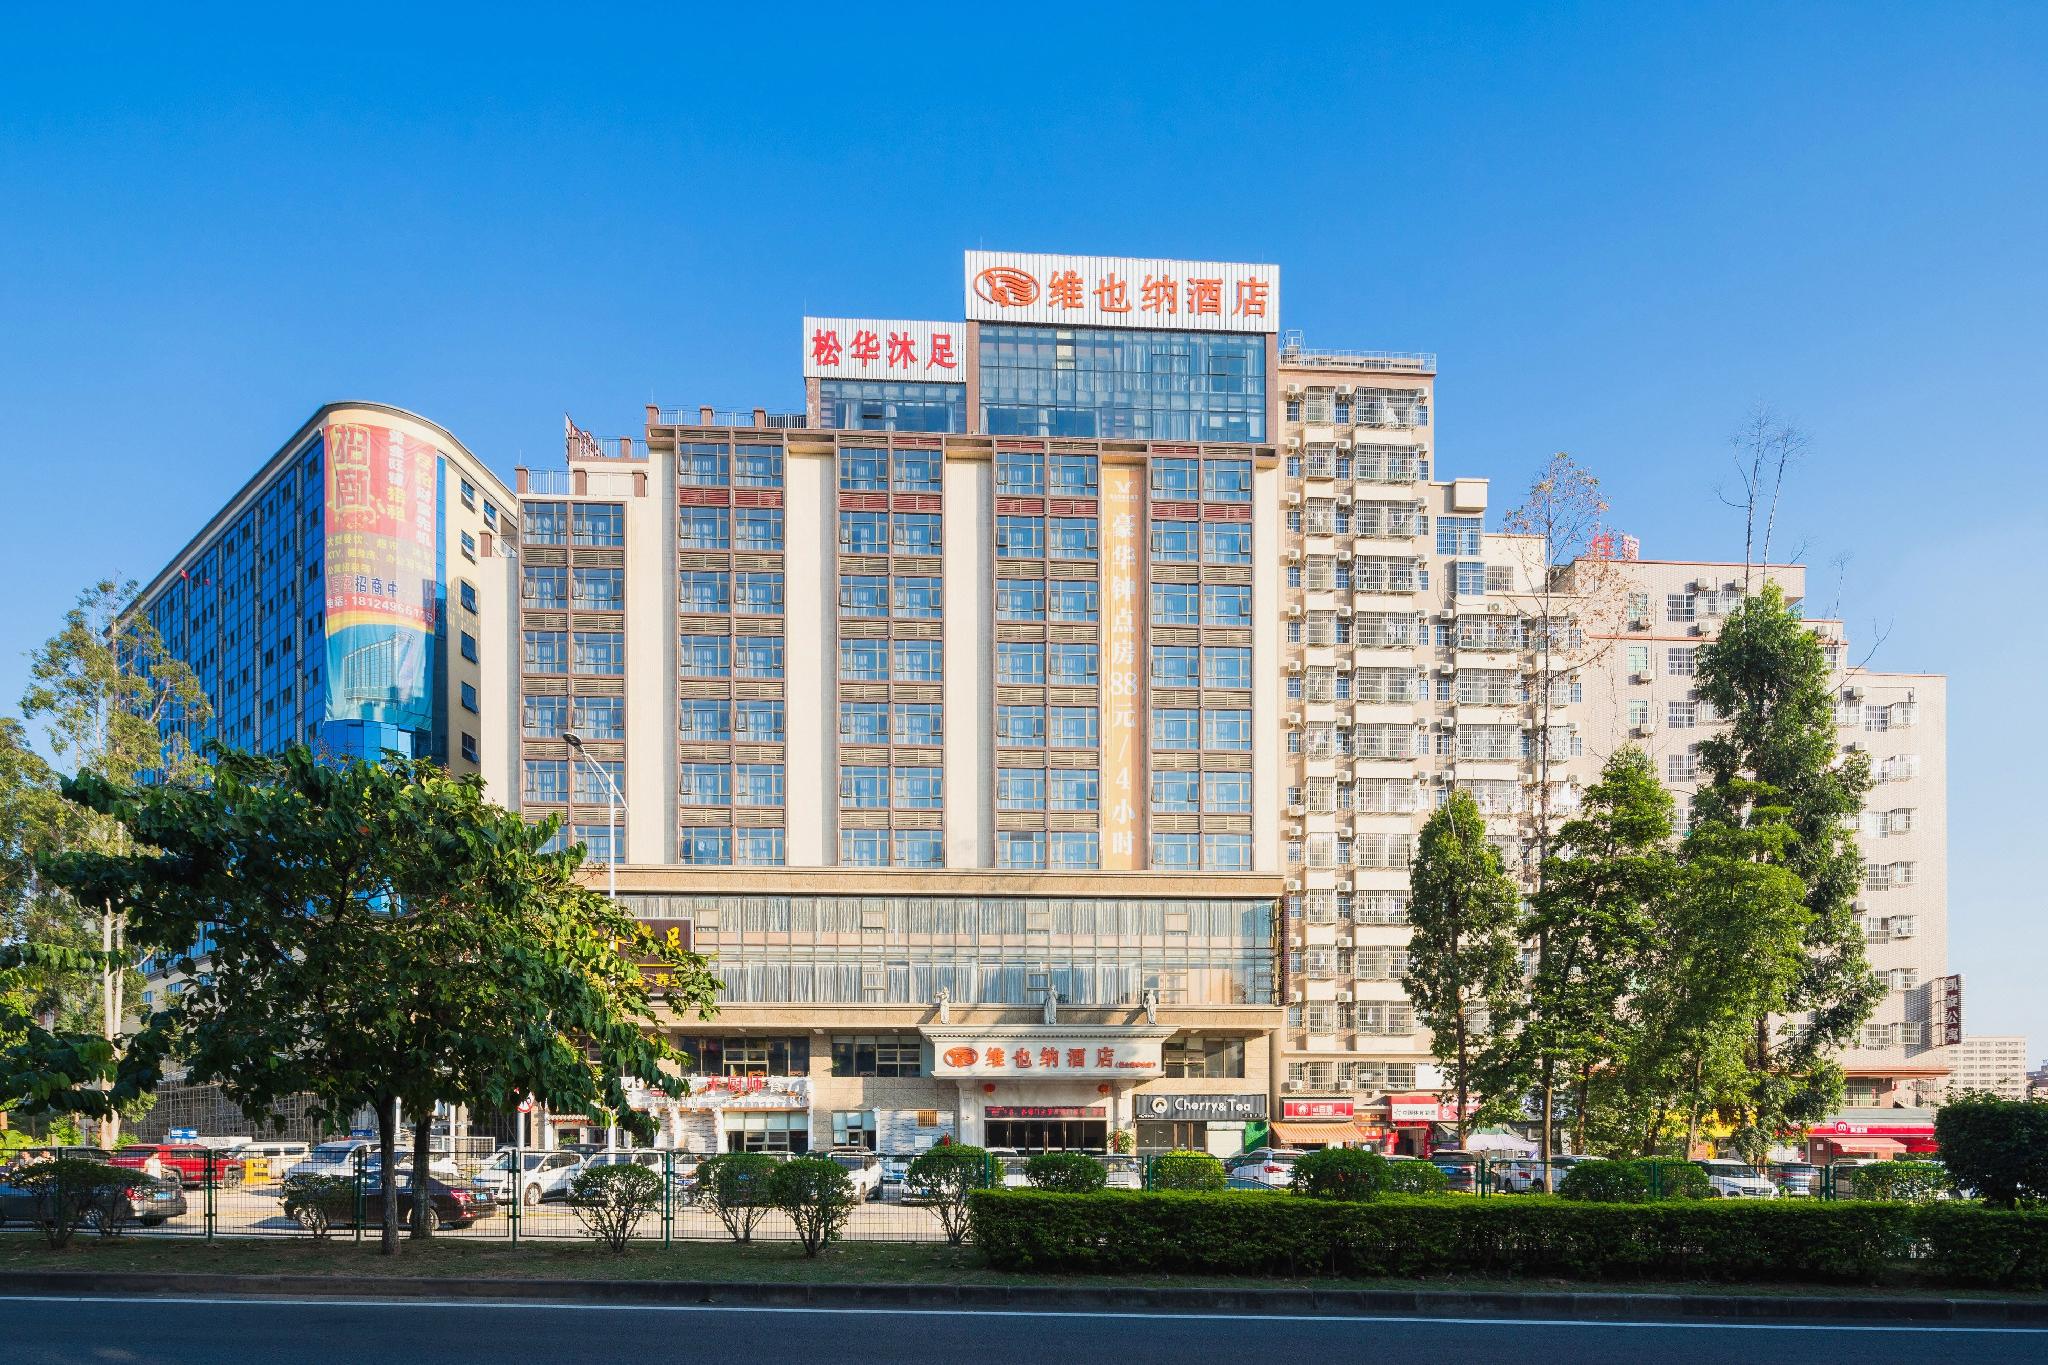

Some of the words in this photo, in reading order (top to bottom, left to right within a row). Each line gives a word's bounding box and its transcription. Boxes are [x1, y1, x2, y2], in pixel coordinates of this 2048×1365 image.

[1047, 269, 1269, 318] 维也纳酒店
[811, 328, 958, 370] 松华沐足
[985, 1046, 1114, 1069] 维也纳酒店
